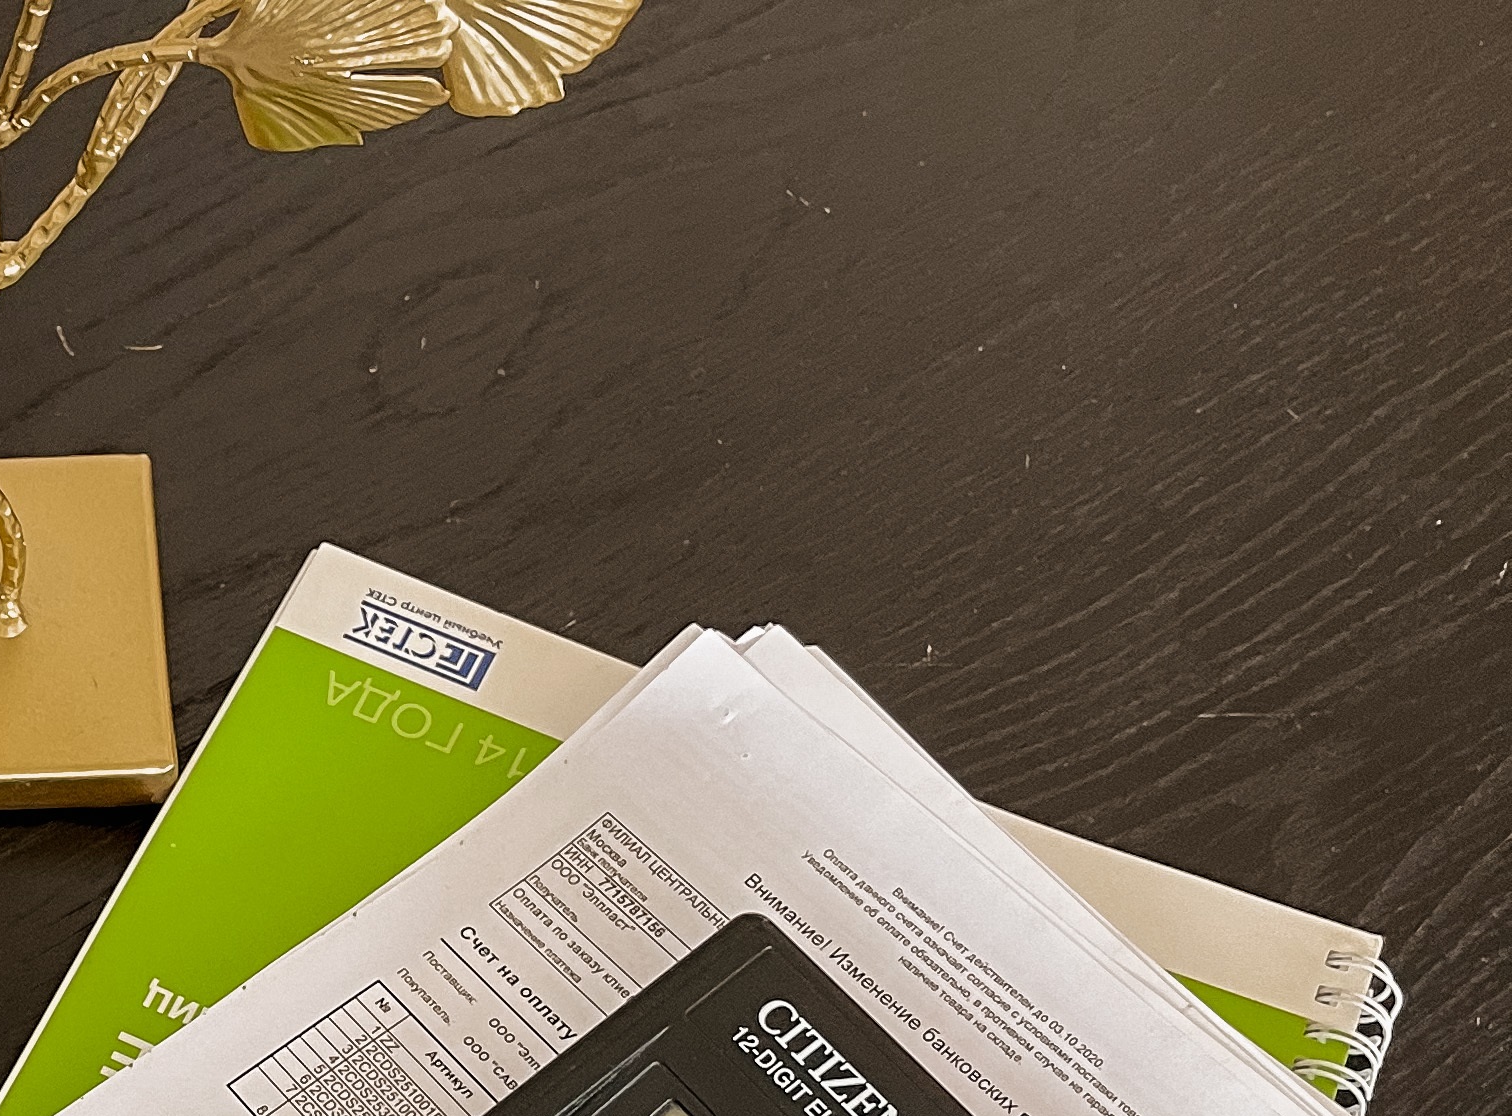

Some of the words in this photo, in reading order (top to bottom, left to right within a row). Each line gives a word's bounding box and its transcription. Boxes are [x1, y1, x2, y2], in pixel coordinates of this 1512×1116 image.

[365, 588, 397, 606] СТЕК
[400, 601, 441, 623] центр
[443, 619, 503, 650] Учебный
[327, 670, 464, 754] ГОДА
[577, 837, 599, 859] Банк
[586, 829, 627, 868] Москва
[602, 819, 652, 864] ФИЛИАЛ
[551, 859, 581, 885] ООО
[564, 846, 594, 874] ИНН
[598, 877, 666, 938] 7715787156
[823, 849, 858, 881] Оплата
[895, 912, 924, 937] счета
[863, 905, 880, 918] об
[513, 888, 553, 928] Оплата
[552, 926, 568, 941] по
[567, 941, 605, 974] заказу
[602, 973, 634, 1003] клие
[892, 887, 945, 933] Внимание!
[943, 931, 968, 954] Счет
[1031, 1010, 1049, 1022] до
[460, 926, 499, 963] Счет
[497, 965, 519, 986] на
[520, 987, 578, 1040] оплату
[744, 873, 832, 951] Внимание!
[829, 947, 921, 1030] Изменение
[922, 1028, 1018, 1114] банковских
[379, 1034, 400, 1054] ZZ
[489, 1018, 515, 1043] ООО
[972, 1020, 987, 1033] на
[463, 1036, 490, 1061] ООО
[733, 1027, 813, 1104] 12-DIGIT
[425, 1052, 474, 1099] Артикул
